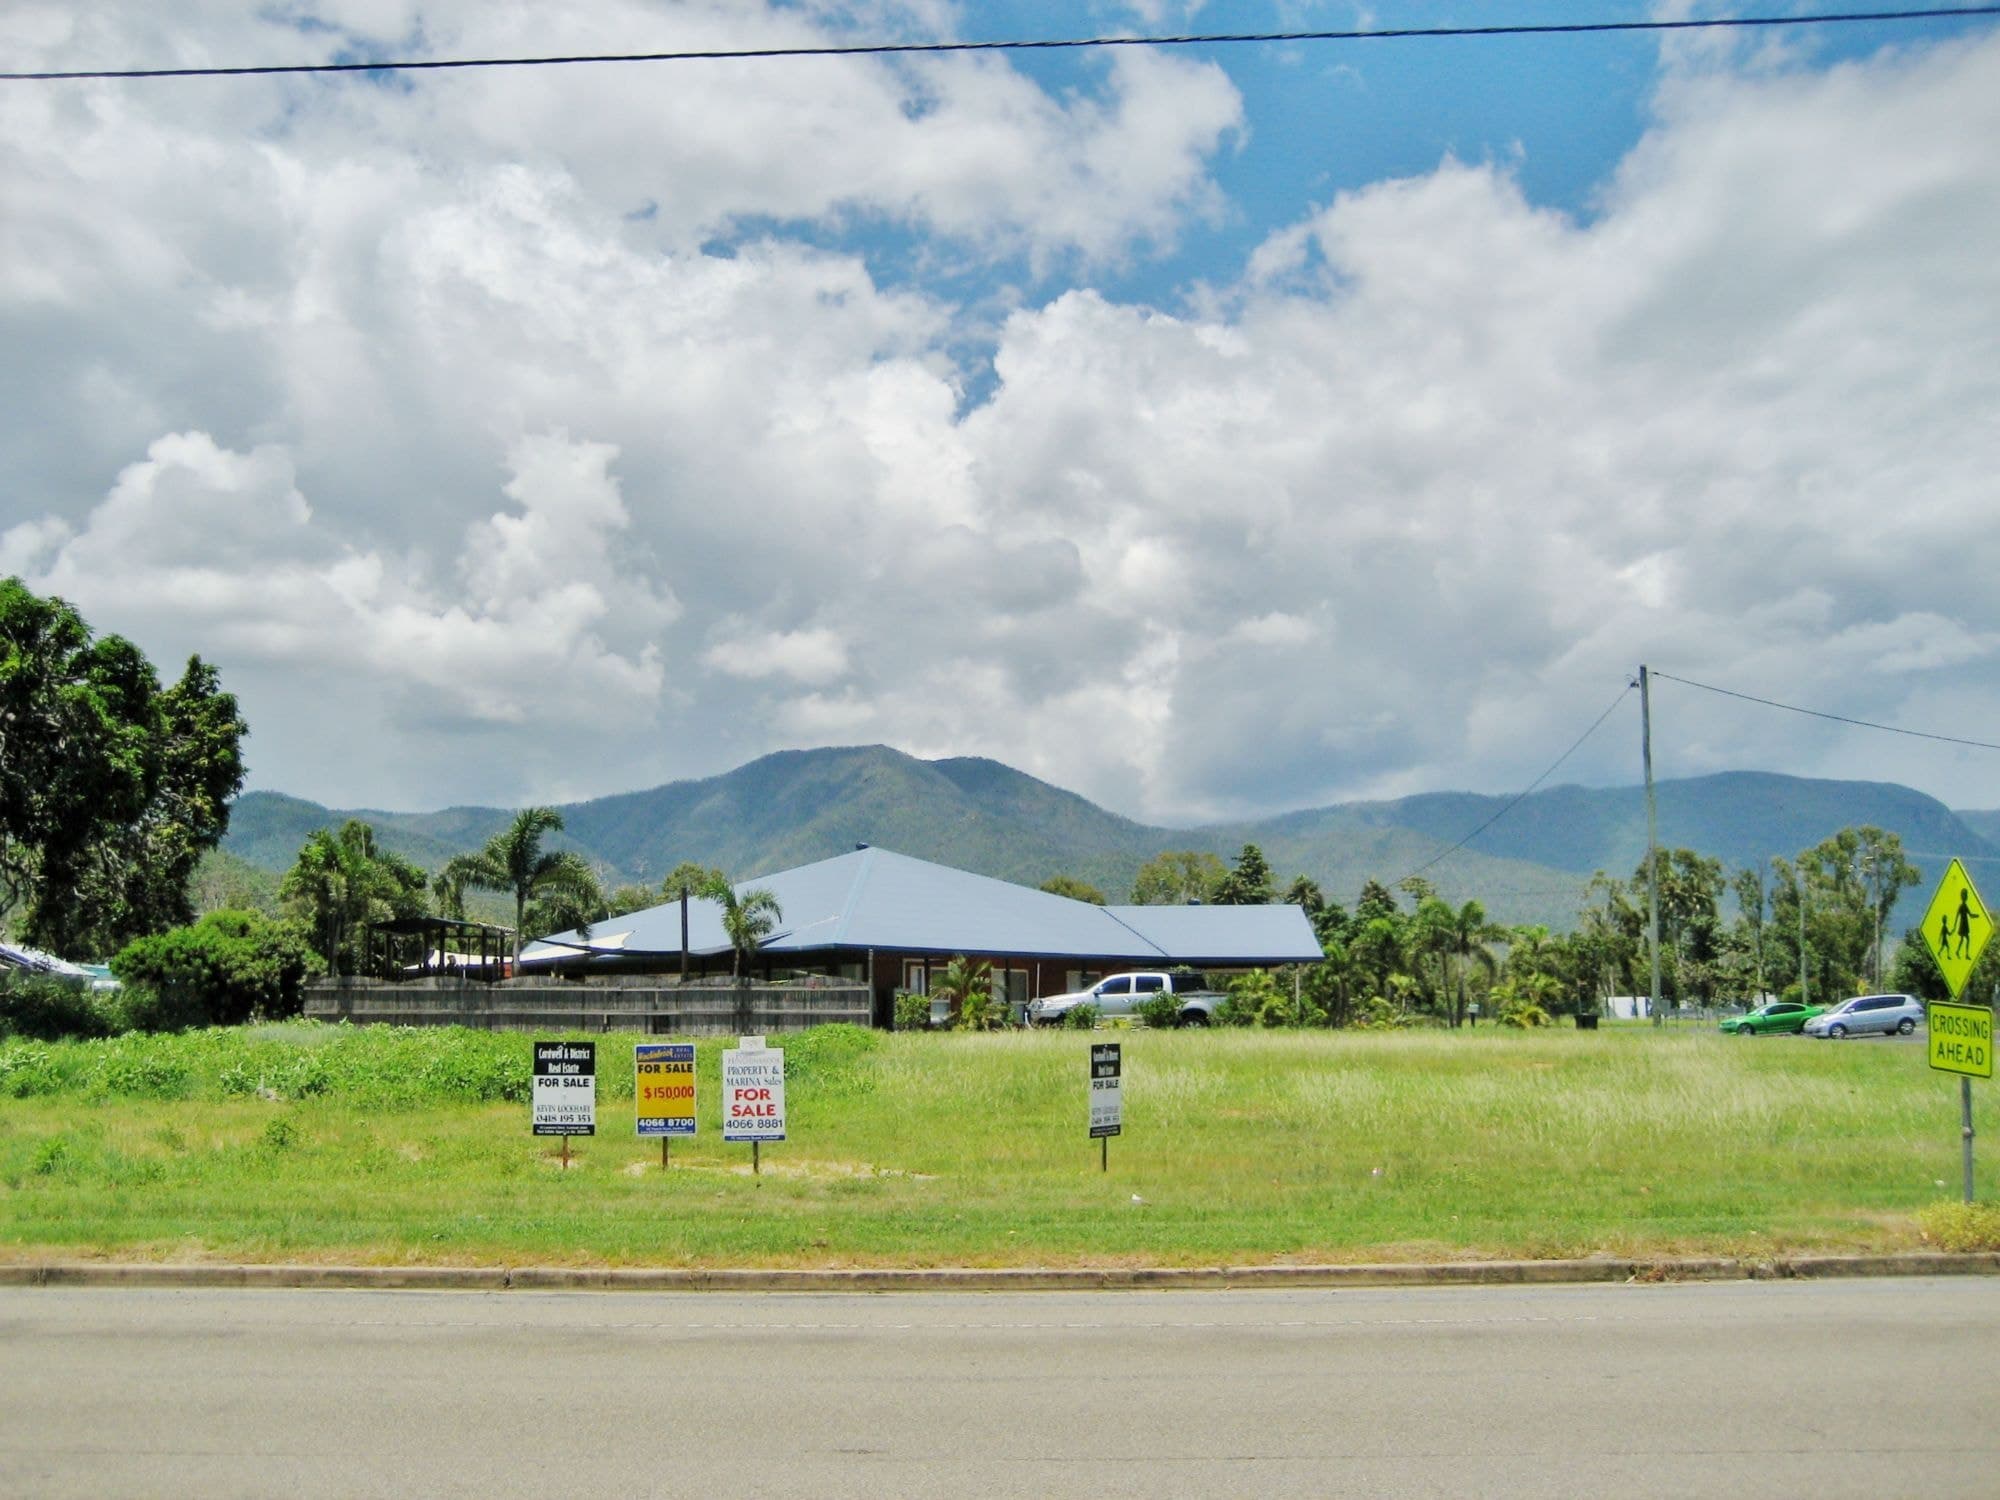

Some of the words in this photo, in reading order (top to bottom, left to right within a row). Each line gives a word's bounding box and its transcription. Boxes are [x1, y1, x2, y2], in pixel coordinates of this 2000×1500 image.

[1932, 1014, 1989, 1039] CROSSING
[1936, 1041, 1984, 1066] AHEAD
[638, 1064, 661, 1074] FOR
[665, 1063, 694, 1073] SALE
[727, 1066, 768, 1075] PROPERTY
[772, 1065, 780, 1074] &
[538, 1078, 559, 1087] FOR
[563, 1078, 590, 1087] SALE
[726, 1077, 761, 1086] MARINA
[735, 1088, 771, 1101] FOR
[731, 1104, 776, 1117] SALE
[638, 1119, 665, 1127] 4066
[667, 1118, 694, 1126] 8700
[726, 1119, 754, 1129] 4066
[757, 1118, 783, 1129] 8881
